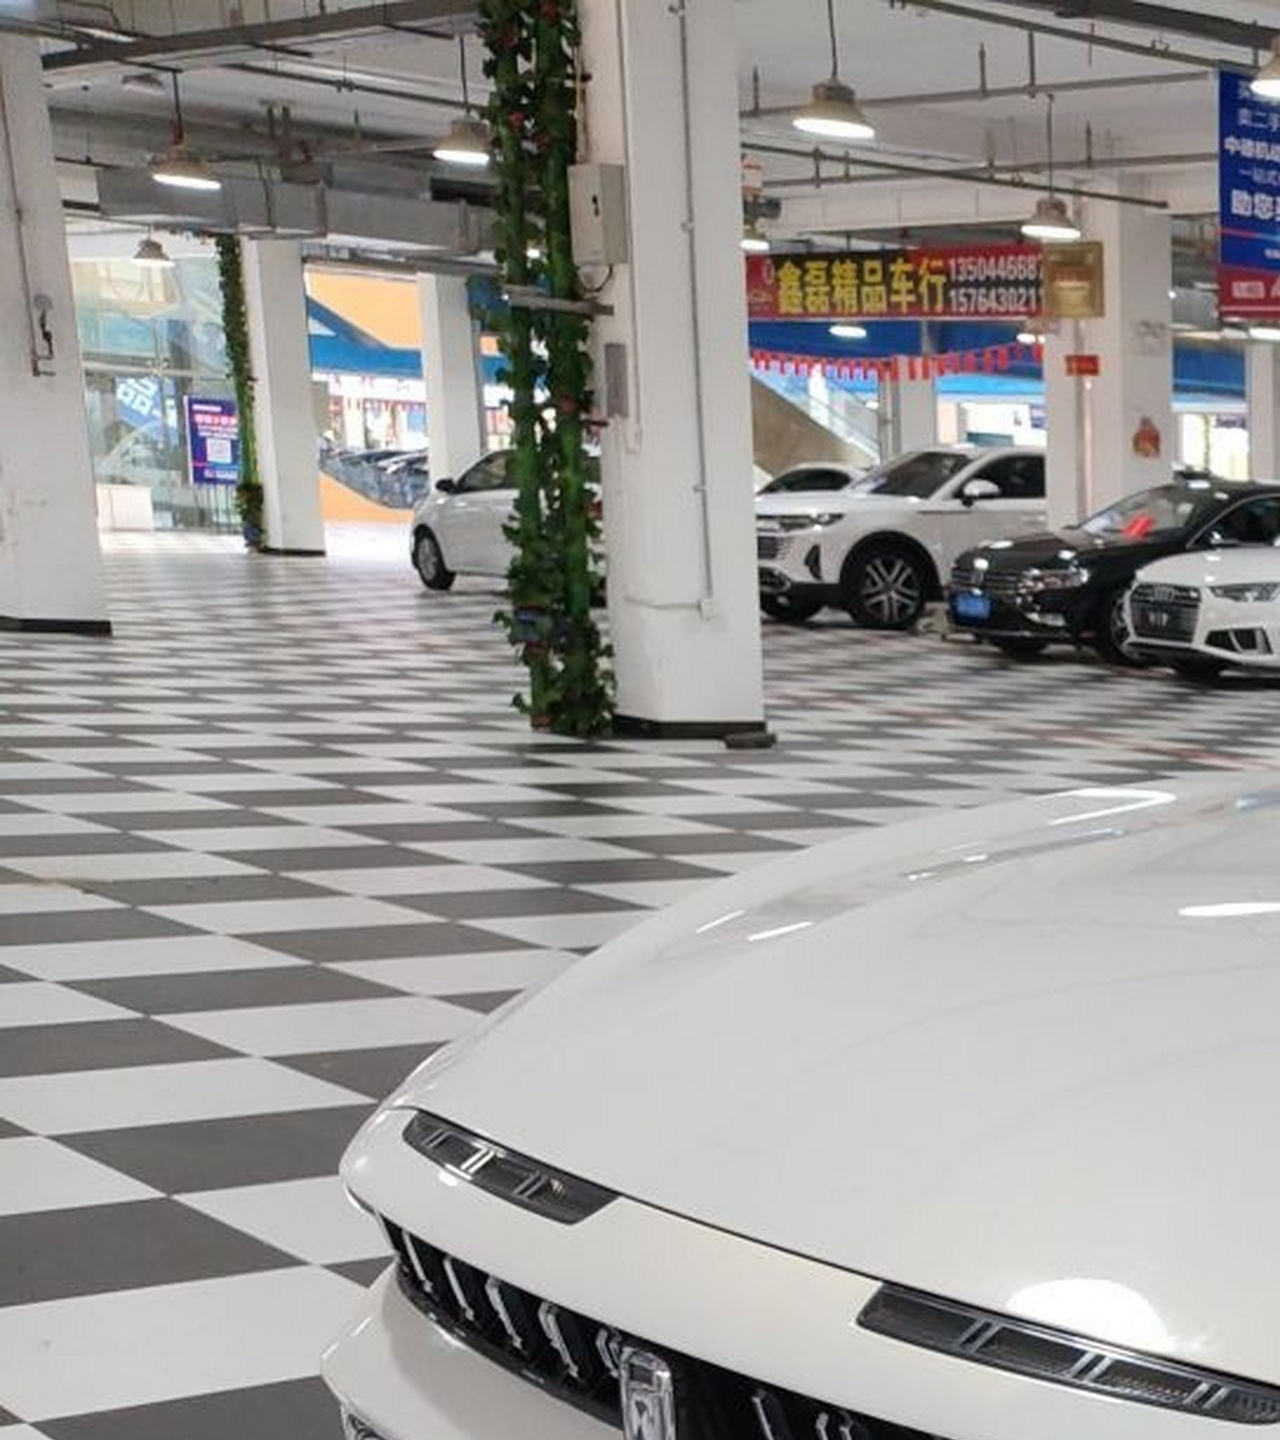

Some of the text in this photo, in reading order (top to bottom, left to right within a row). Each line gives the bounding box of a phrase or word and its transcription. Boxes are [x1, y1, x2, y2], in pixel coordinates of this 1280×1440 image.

[777, 257, 947, 315] 鑫磊精品车行
